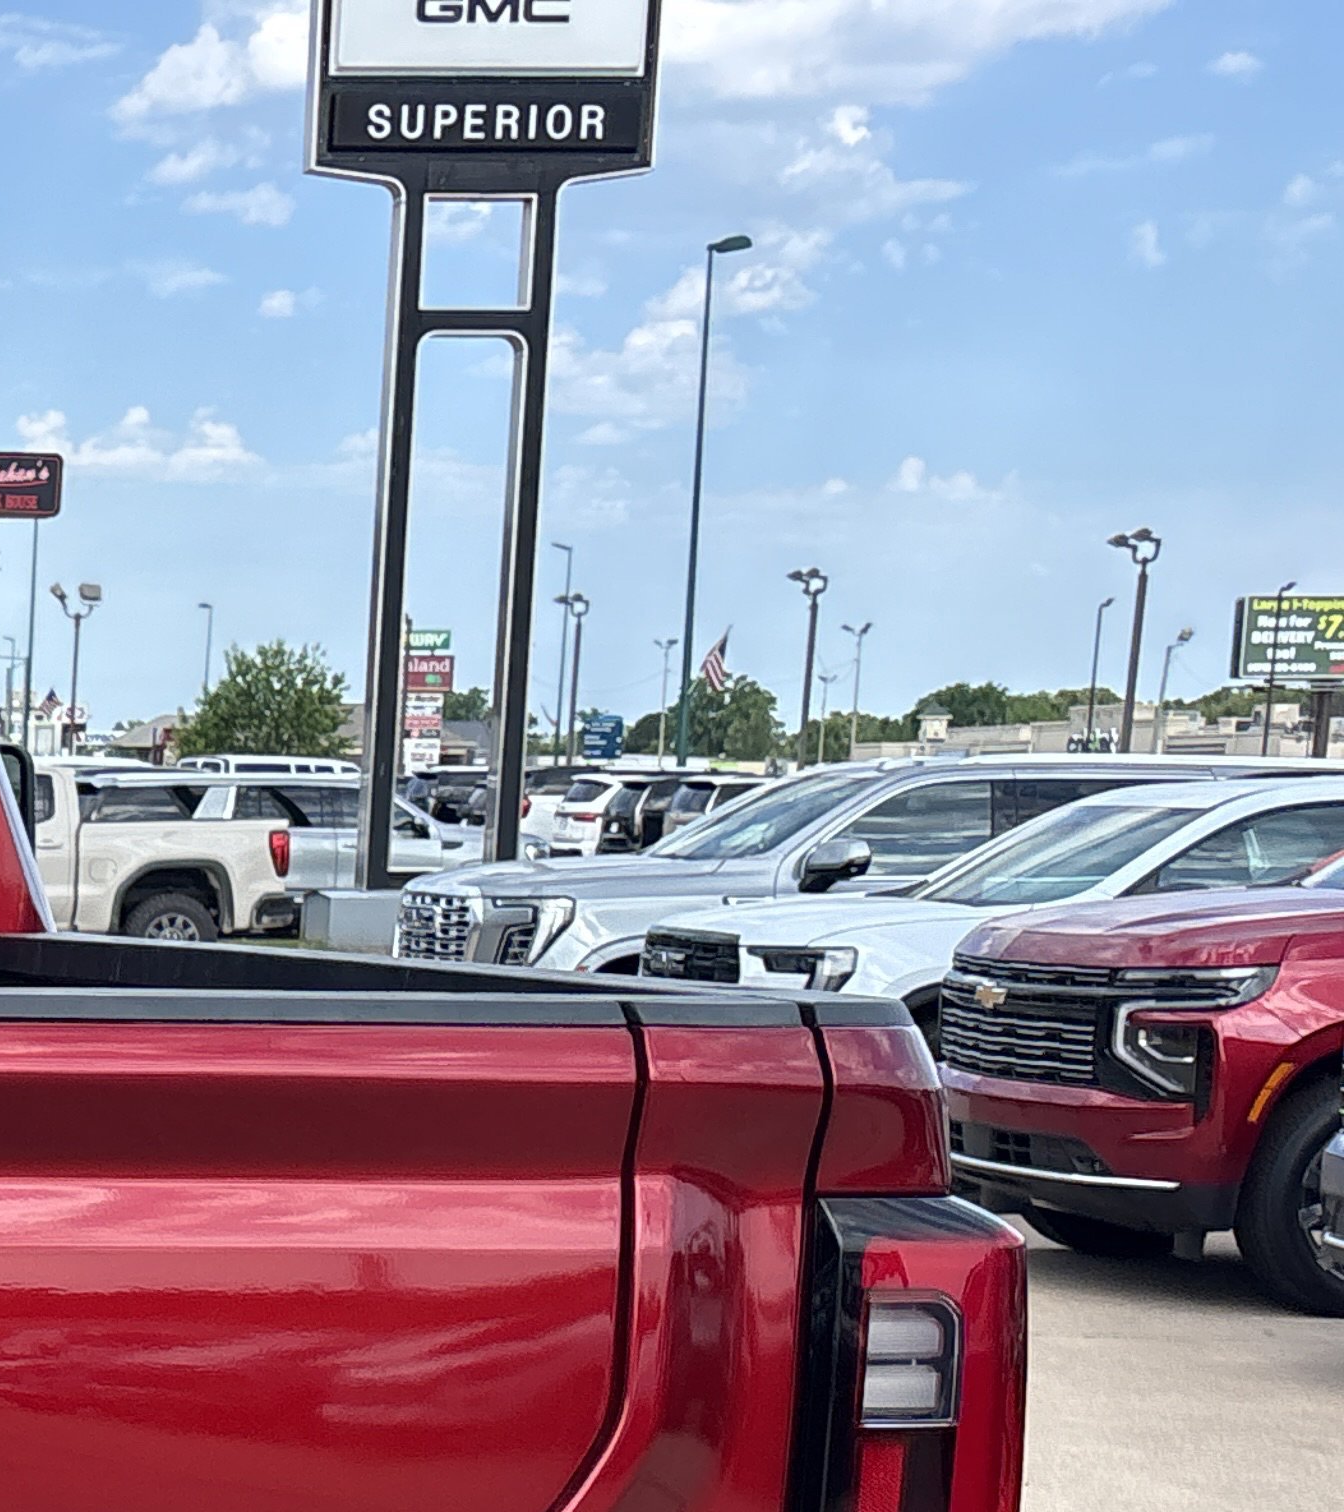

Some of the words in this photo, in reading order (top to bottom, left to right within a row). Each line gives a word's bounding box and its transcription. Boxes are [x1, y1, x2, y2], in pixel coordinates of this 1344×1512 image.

[416, 0, 570, 24] GMC
[367, 103, 605, 140] SUPERIOR
[5, 495, 38, 509] HOUSE
